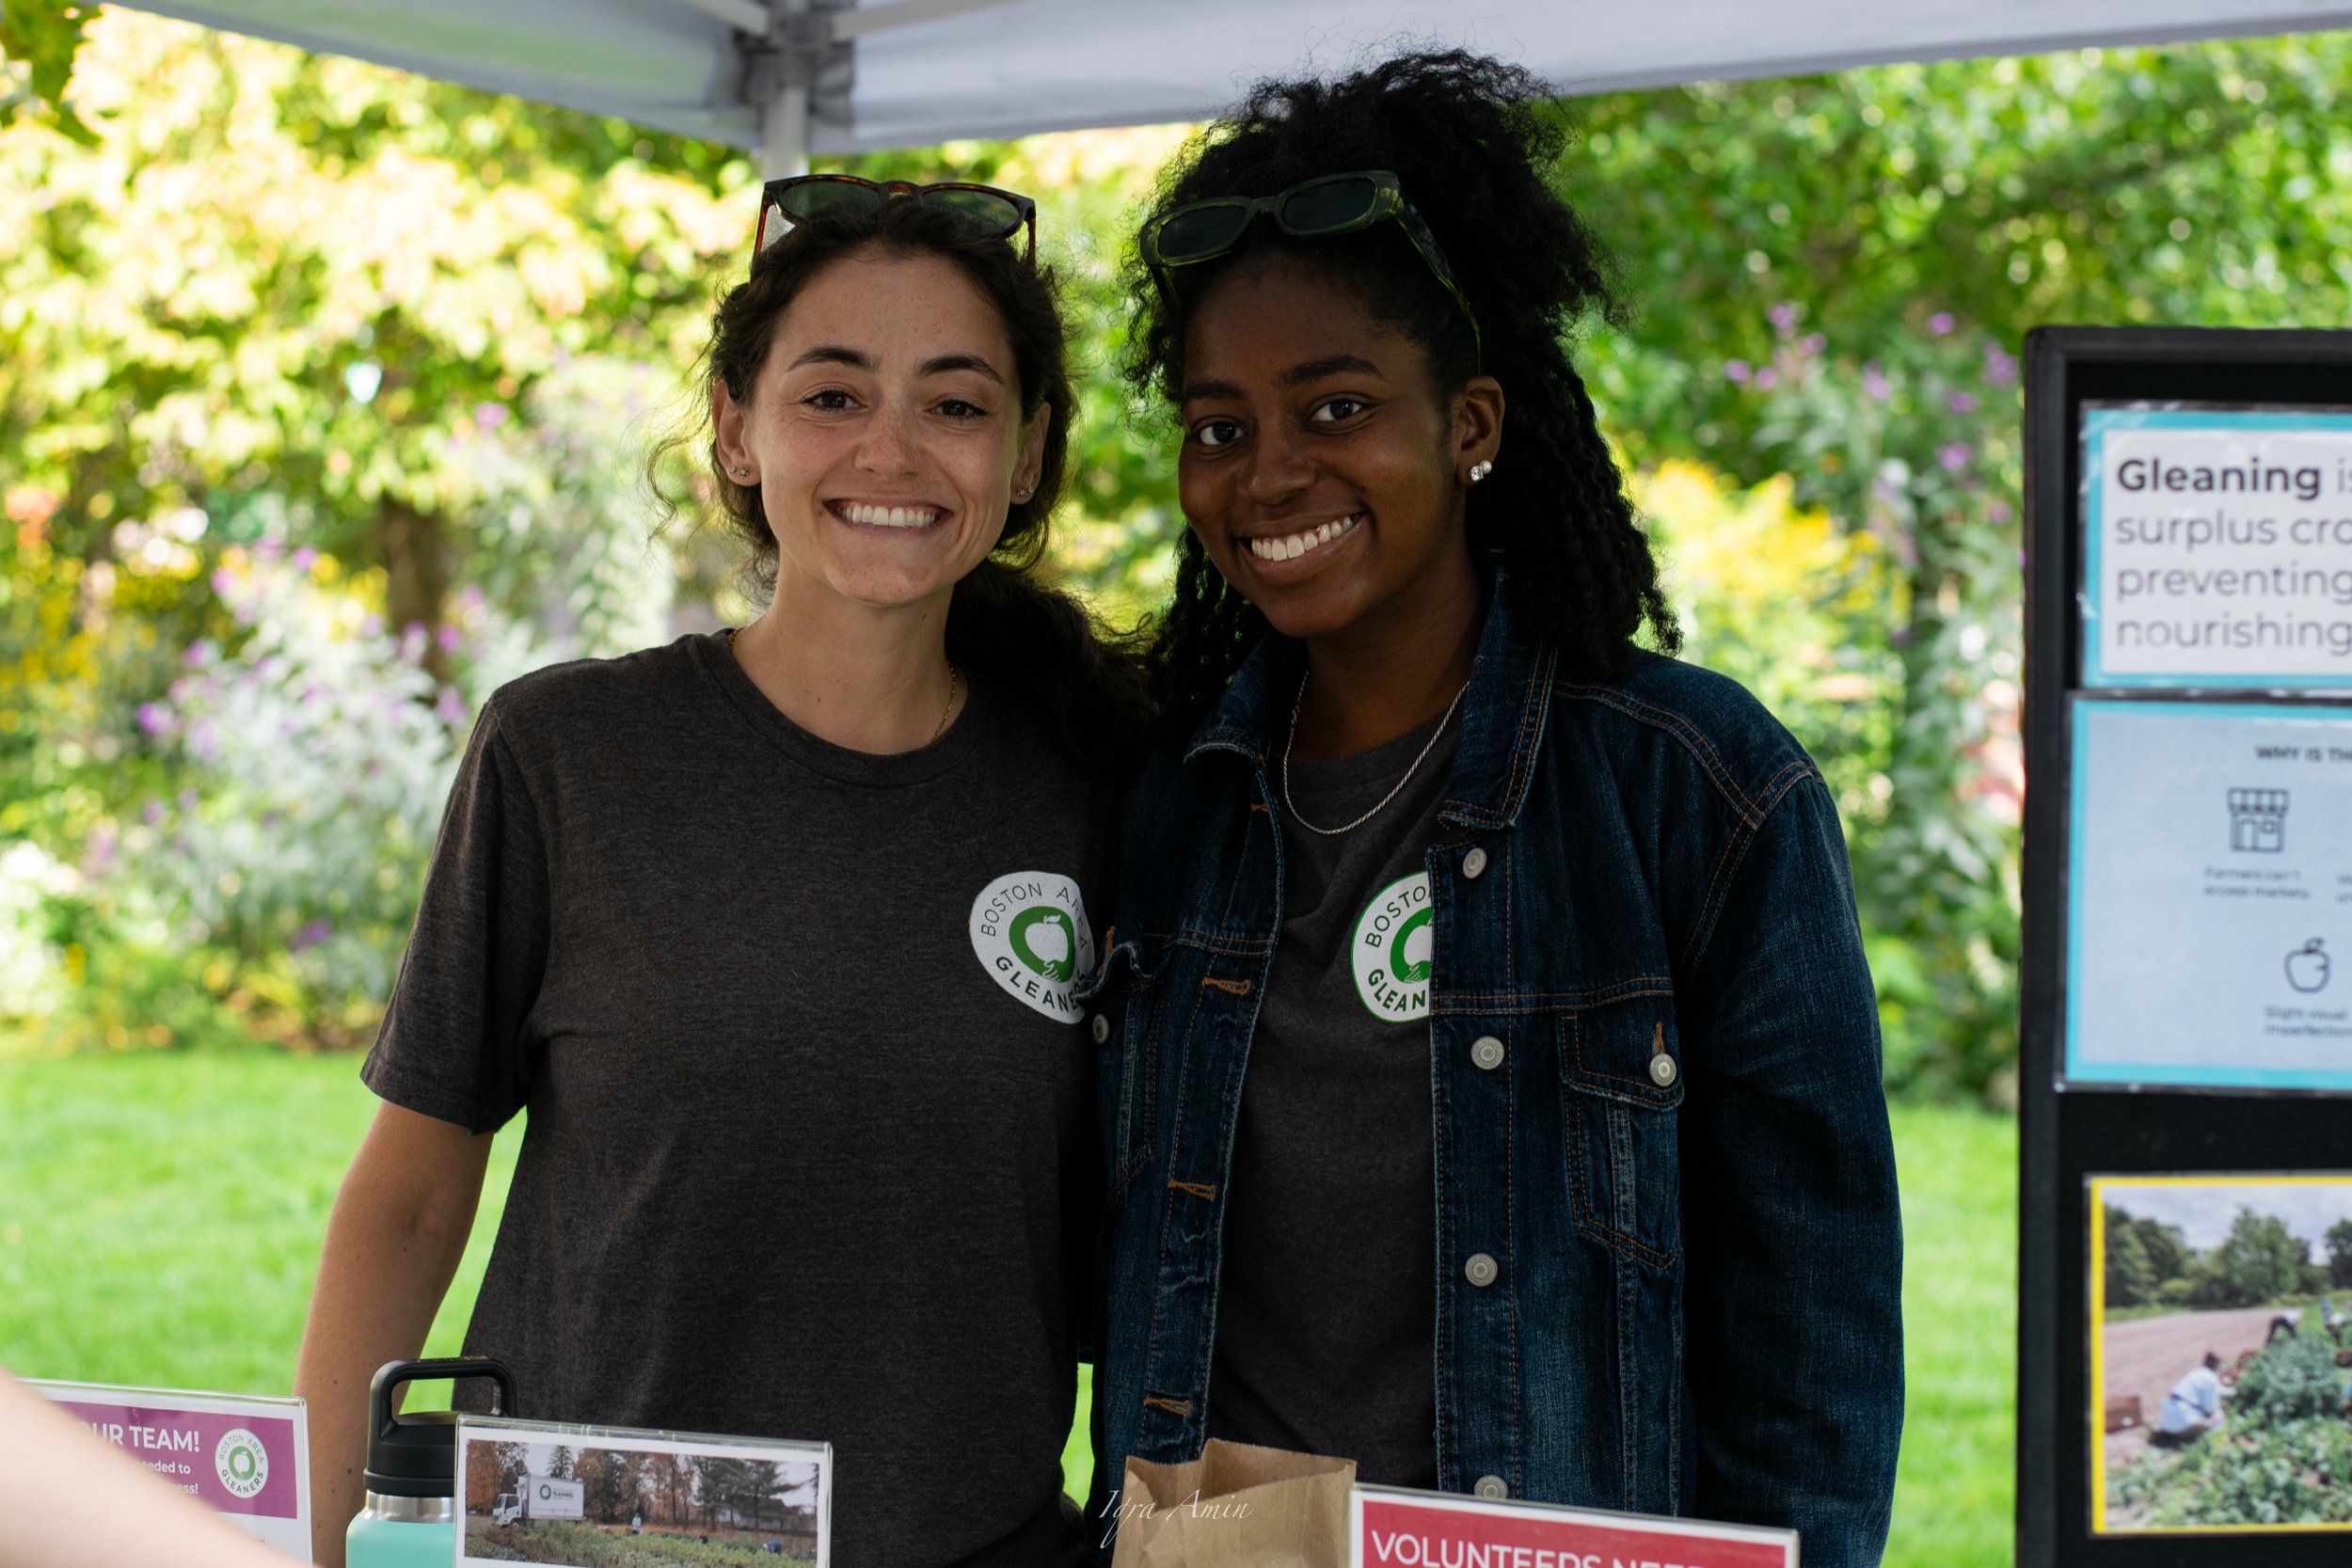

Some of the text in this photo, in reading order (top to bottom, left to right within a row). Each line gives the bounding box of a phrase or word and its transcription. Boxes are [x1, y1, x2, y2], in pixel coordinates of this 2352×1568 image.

[2118, 456, 2321, 500] Gleaning
[2116, 509, 2278, 551] surplus
[2118, 561, 2352, 605] preventing
[2117, 612, 2352, 656] nourishing
[2255, 745, 2300, 759] WHY
[2305, 746, 2323, 761] IS
[981, 882, 1088, 950] BOSTON AREA
[1365, 885, 1431, 948] BOSTO
[1368, 969, 1426, 1012] GLEAN
[129, 1425, 199, 1452] TEAM!
[219, 1433, 264, 1464] BOSTON AREA
[178, 1463, 191, 1474] to
[221, 1469, 263, 1494] GLEANERS
